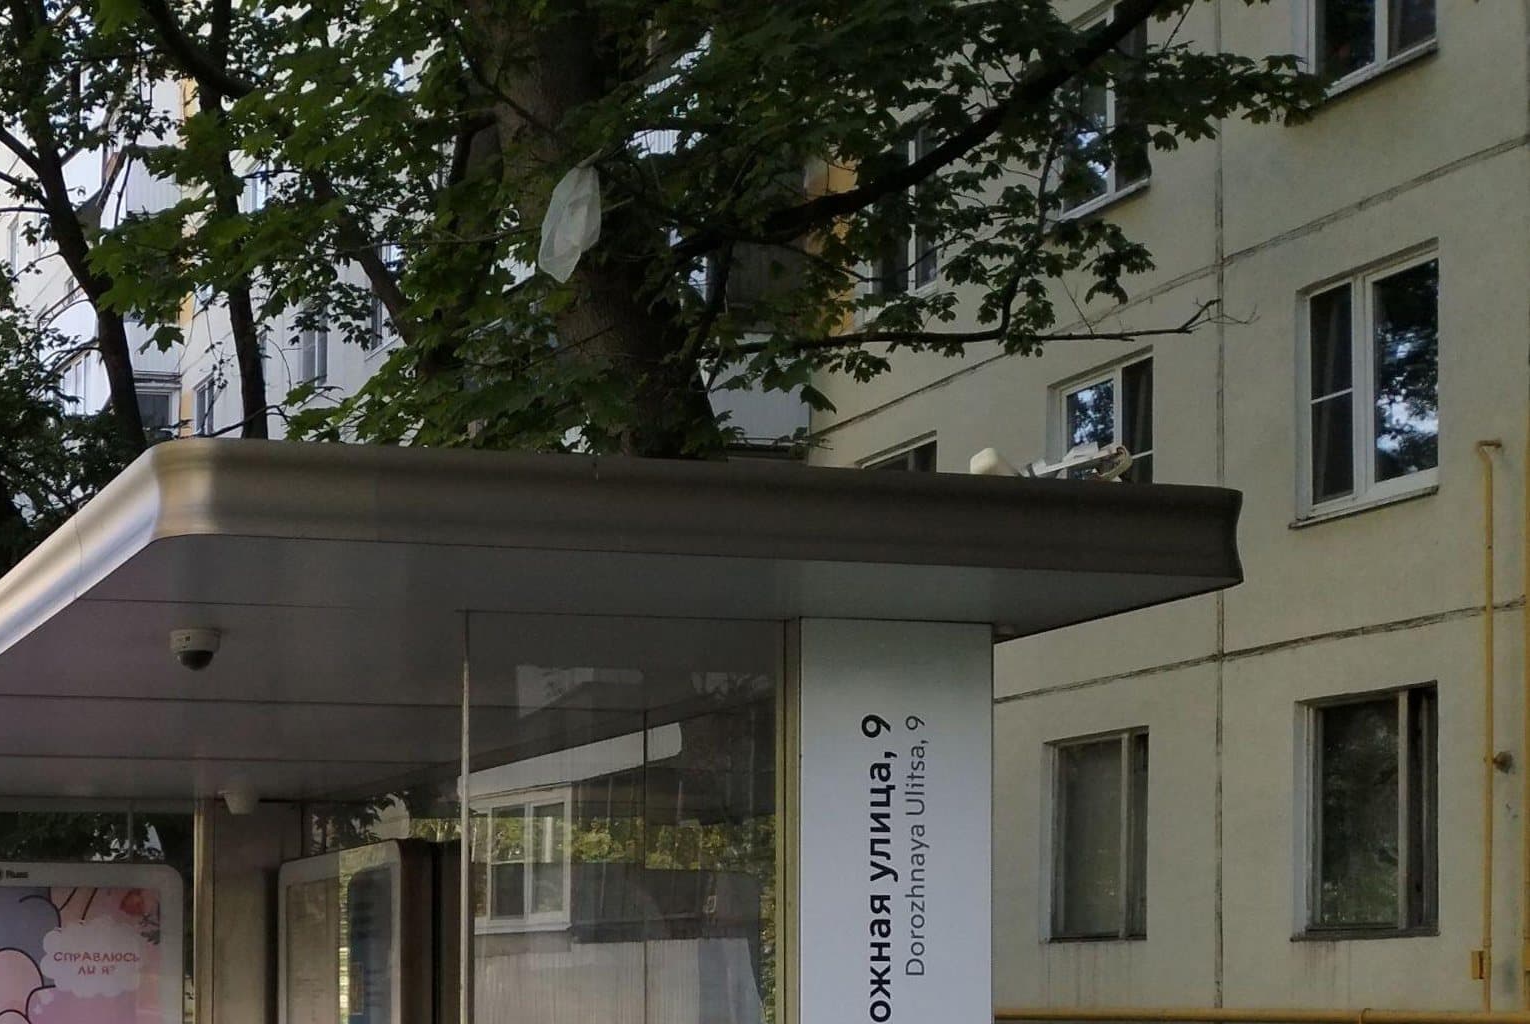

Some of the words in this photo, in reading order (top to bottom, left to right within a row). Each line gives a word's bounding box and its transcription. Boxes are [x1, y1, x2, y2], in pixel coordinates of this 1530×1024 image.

[861, 713, 892, 738] 9
[905, 714, 926, 732] 9
[905, 739, 929, 816] Ulitsa,
[869, 751, 899, 882] улица,
[905, 823, 930, 977] Dorozhnaya
[53, 951, 141, 963] СПРАВЛЮСЬ
[77, 965, 97, 976] ЛИ
